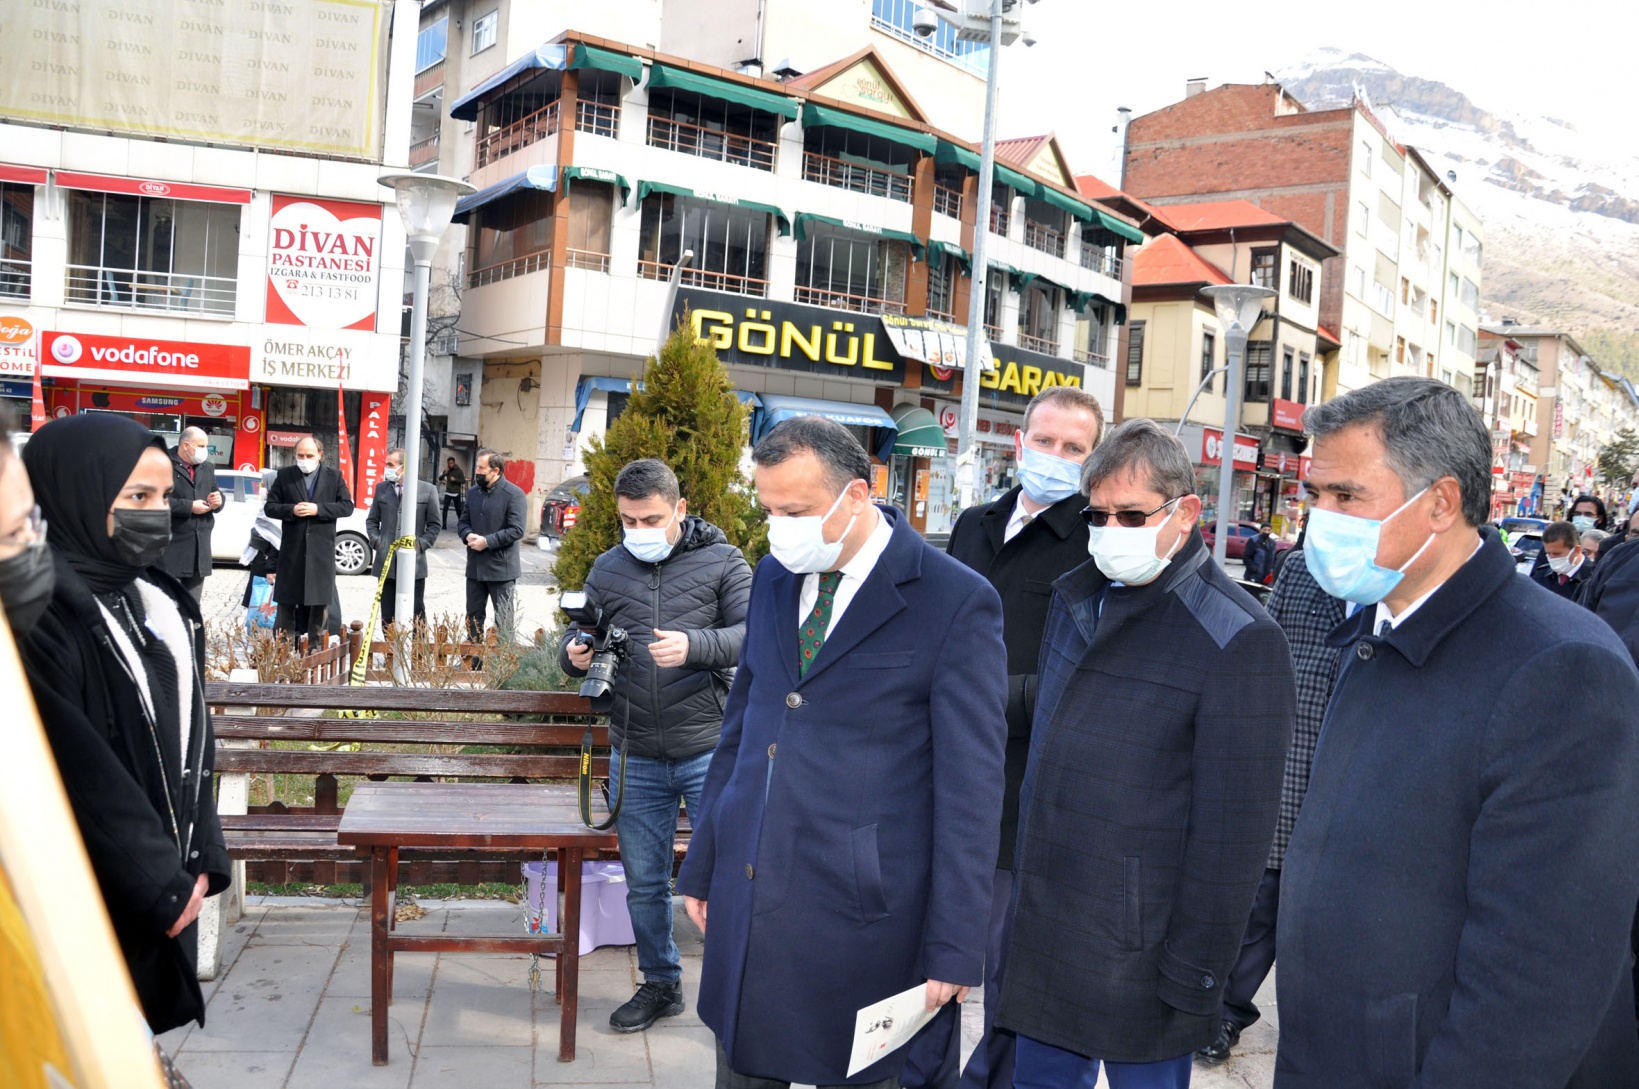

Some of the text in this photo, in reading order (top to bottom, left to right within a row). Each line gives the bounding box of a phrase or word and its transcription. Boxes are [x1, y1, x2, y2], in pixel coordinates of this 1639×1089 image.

[272, 224, 375, 258] DİVAN
[272, 253, 371, 272] PASTANESİ
[310, 271, 317, 280] &
[320, 272, 372, 284] FASTFOOD
[302, 285, 322, 297] 213
[329, 288, 341, 298] 13
[344, 289, 358, 300] 81
[0, 321, 32, 339] oğa
[690, 308, 894, 370] GÖNÜL
[90, 344, 199, 368] vodafone
[264, 338, 352, 360] ÖMER AKÇAY
[263, 357, 350, 380] İŞ MERKEZİ
[142, 397, 178, 406] SAMSUNG
[367, 401, 380, 438] PALA
[582, 752, 590, 775] Nikon
